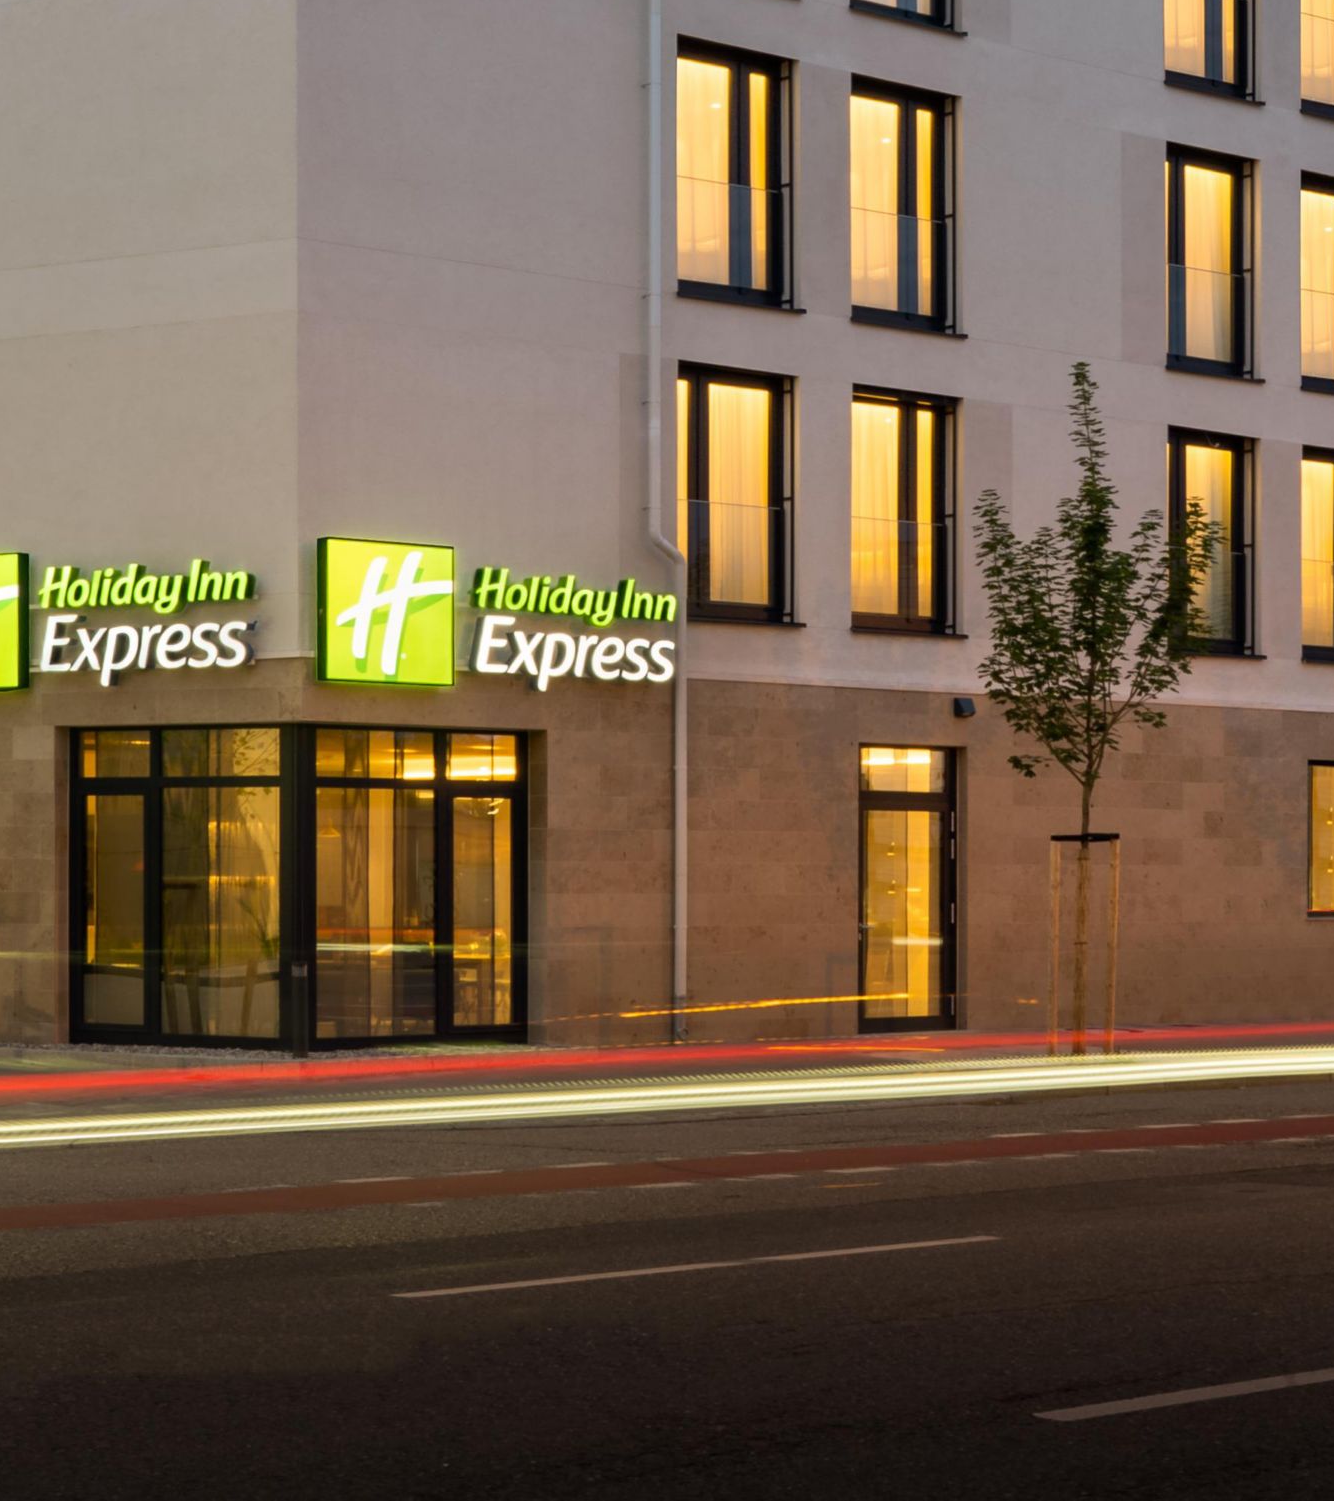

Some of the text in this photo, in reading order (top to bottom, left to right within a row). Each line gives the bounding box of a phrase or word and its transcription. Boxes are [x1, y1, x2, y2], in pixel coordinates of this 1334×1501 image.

[38, 558, 248, 614] Holiday Inn
[475, 566, 677, 627] Holiday Inn
[39, 613, 248, 688] Express
[475, 614, 676, 693] Express
